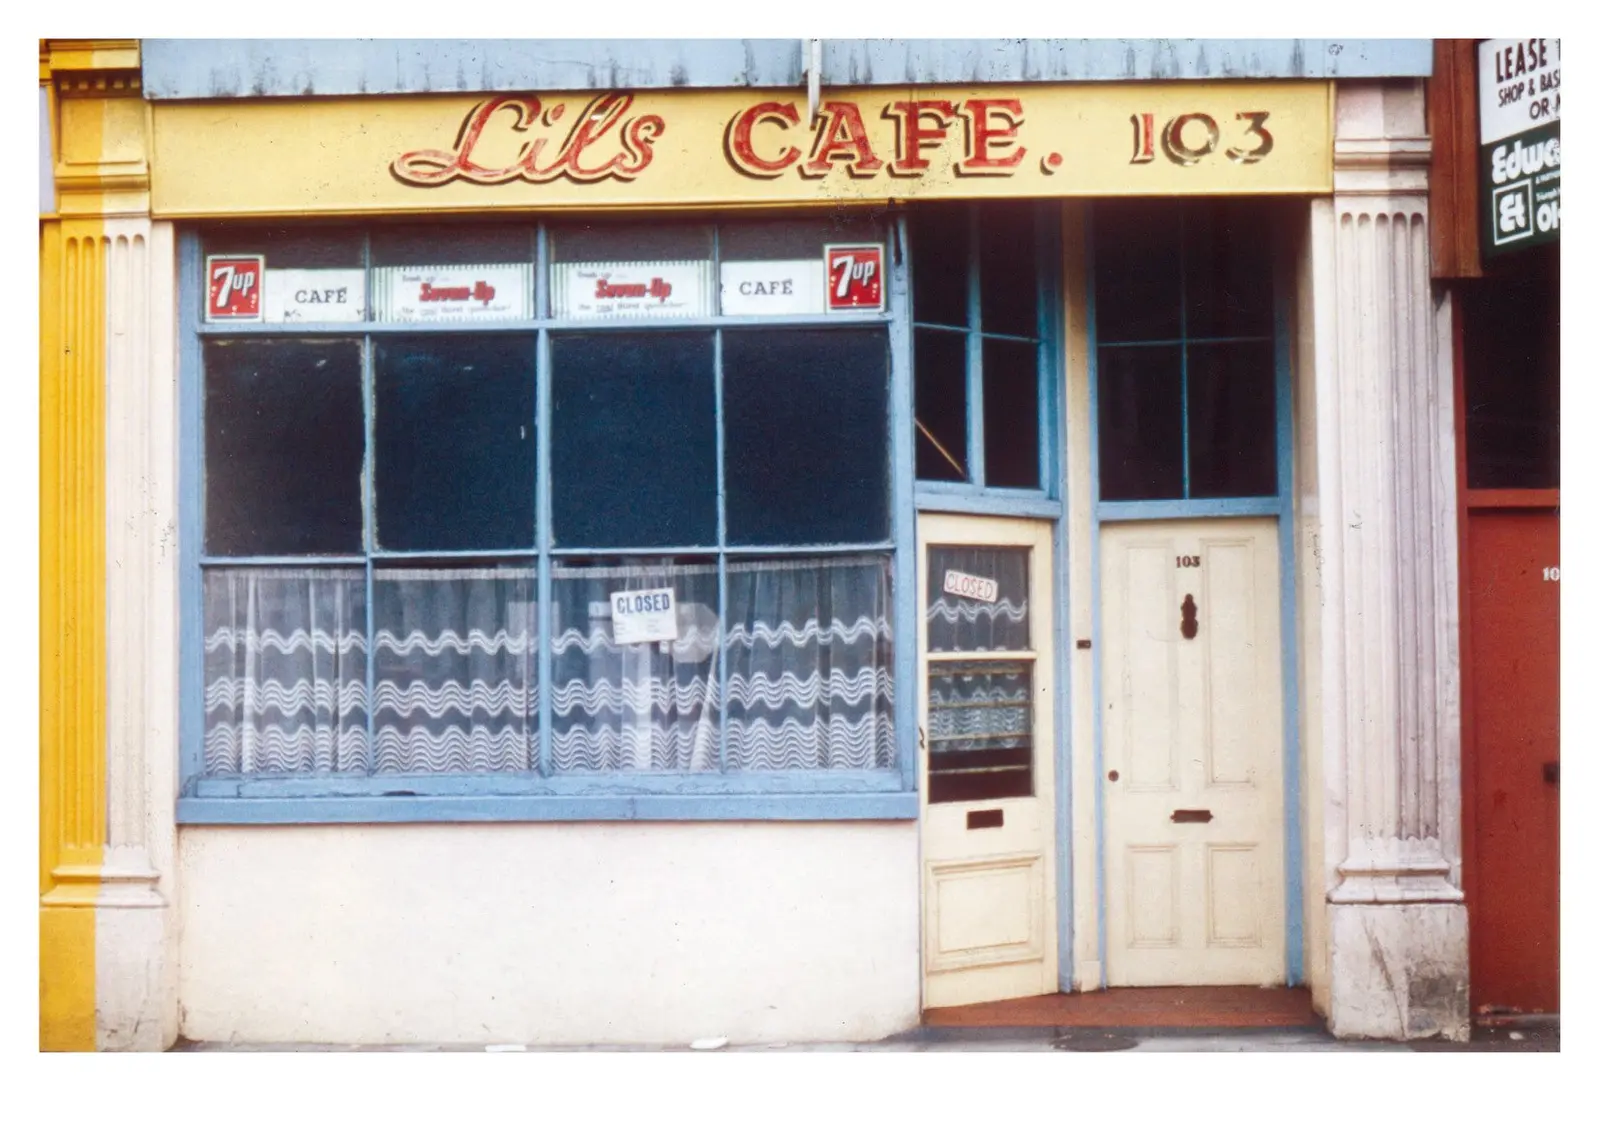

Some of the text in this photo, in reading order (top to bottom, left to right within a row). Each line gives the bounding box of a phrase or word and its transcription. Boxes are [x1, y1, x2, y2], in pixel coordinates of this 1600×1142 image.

[1496, 39, 1548, 84] LEASE
[1498, 68, 1561, 108] SHOP & BAS
[1529, 97, 1550, 120] OR
[389, 92, 1275, 188] Lils CAFE. 103
[1175, 555, 1201, 568] 103
[946, 573, 993, 599] CLOSED
[616, 593, 670, 614] CLOSED
